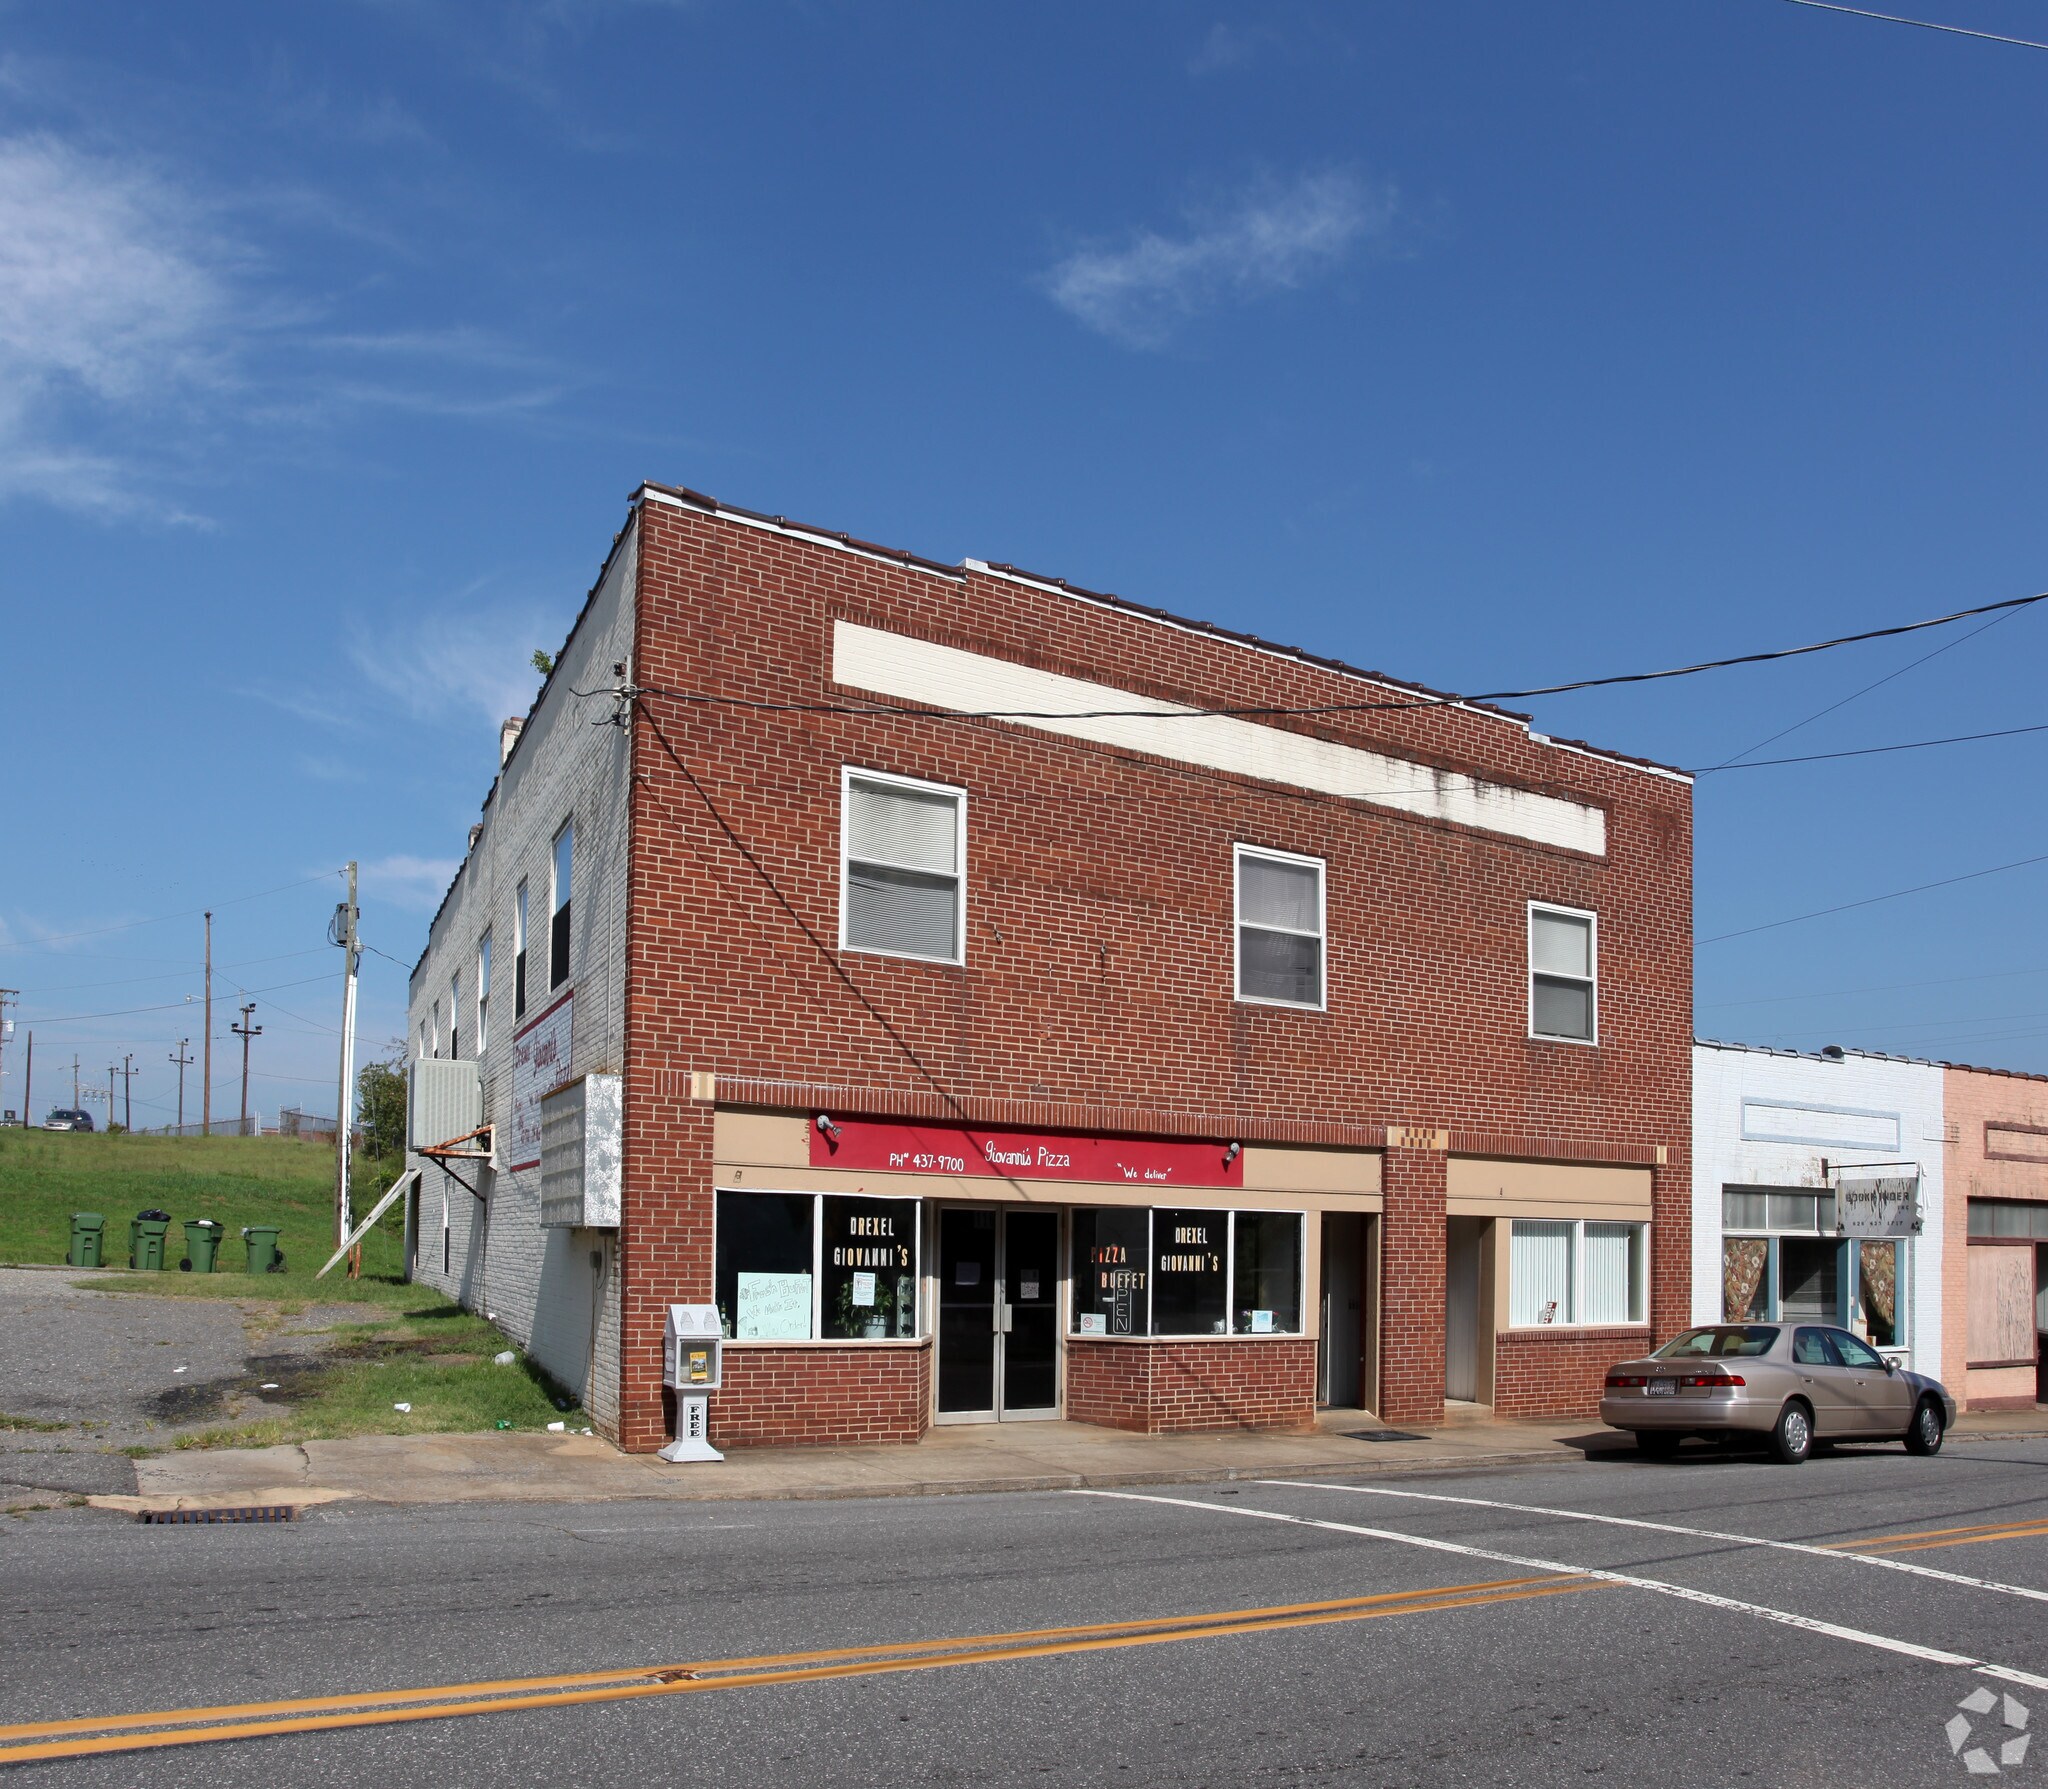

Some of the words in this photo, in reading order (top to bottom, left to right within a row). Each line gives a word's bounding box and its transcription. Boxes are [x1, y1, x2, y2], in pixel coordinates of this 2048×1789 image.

[913, 1154, 964, 1172] 437-9700
[1037, 1146, 1070, 1167] Pizza
[850, 1216, 895, 1237] DREXEL
[1175, 1227, 1208, 1244] DREXEL
[1090, 1246, 1127, 1263] PIZZA
[1101, 1272, 1146, 1290] BUFFET
[690, 1406, 700, 1437] FREE
